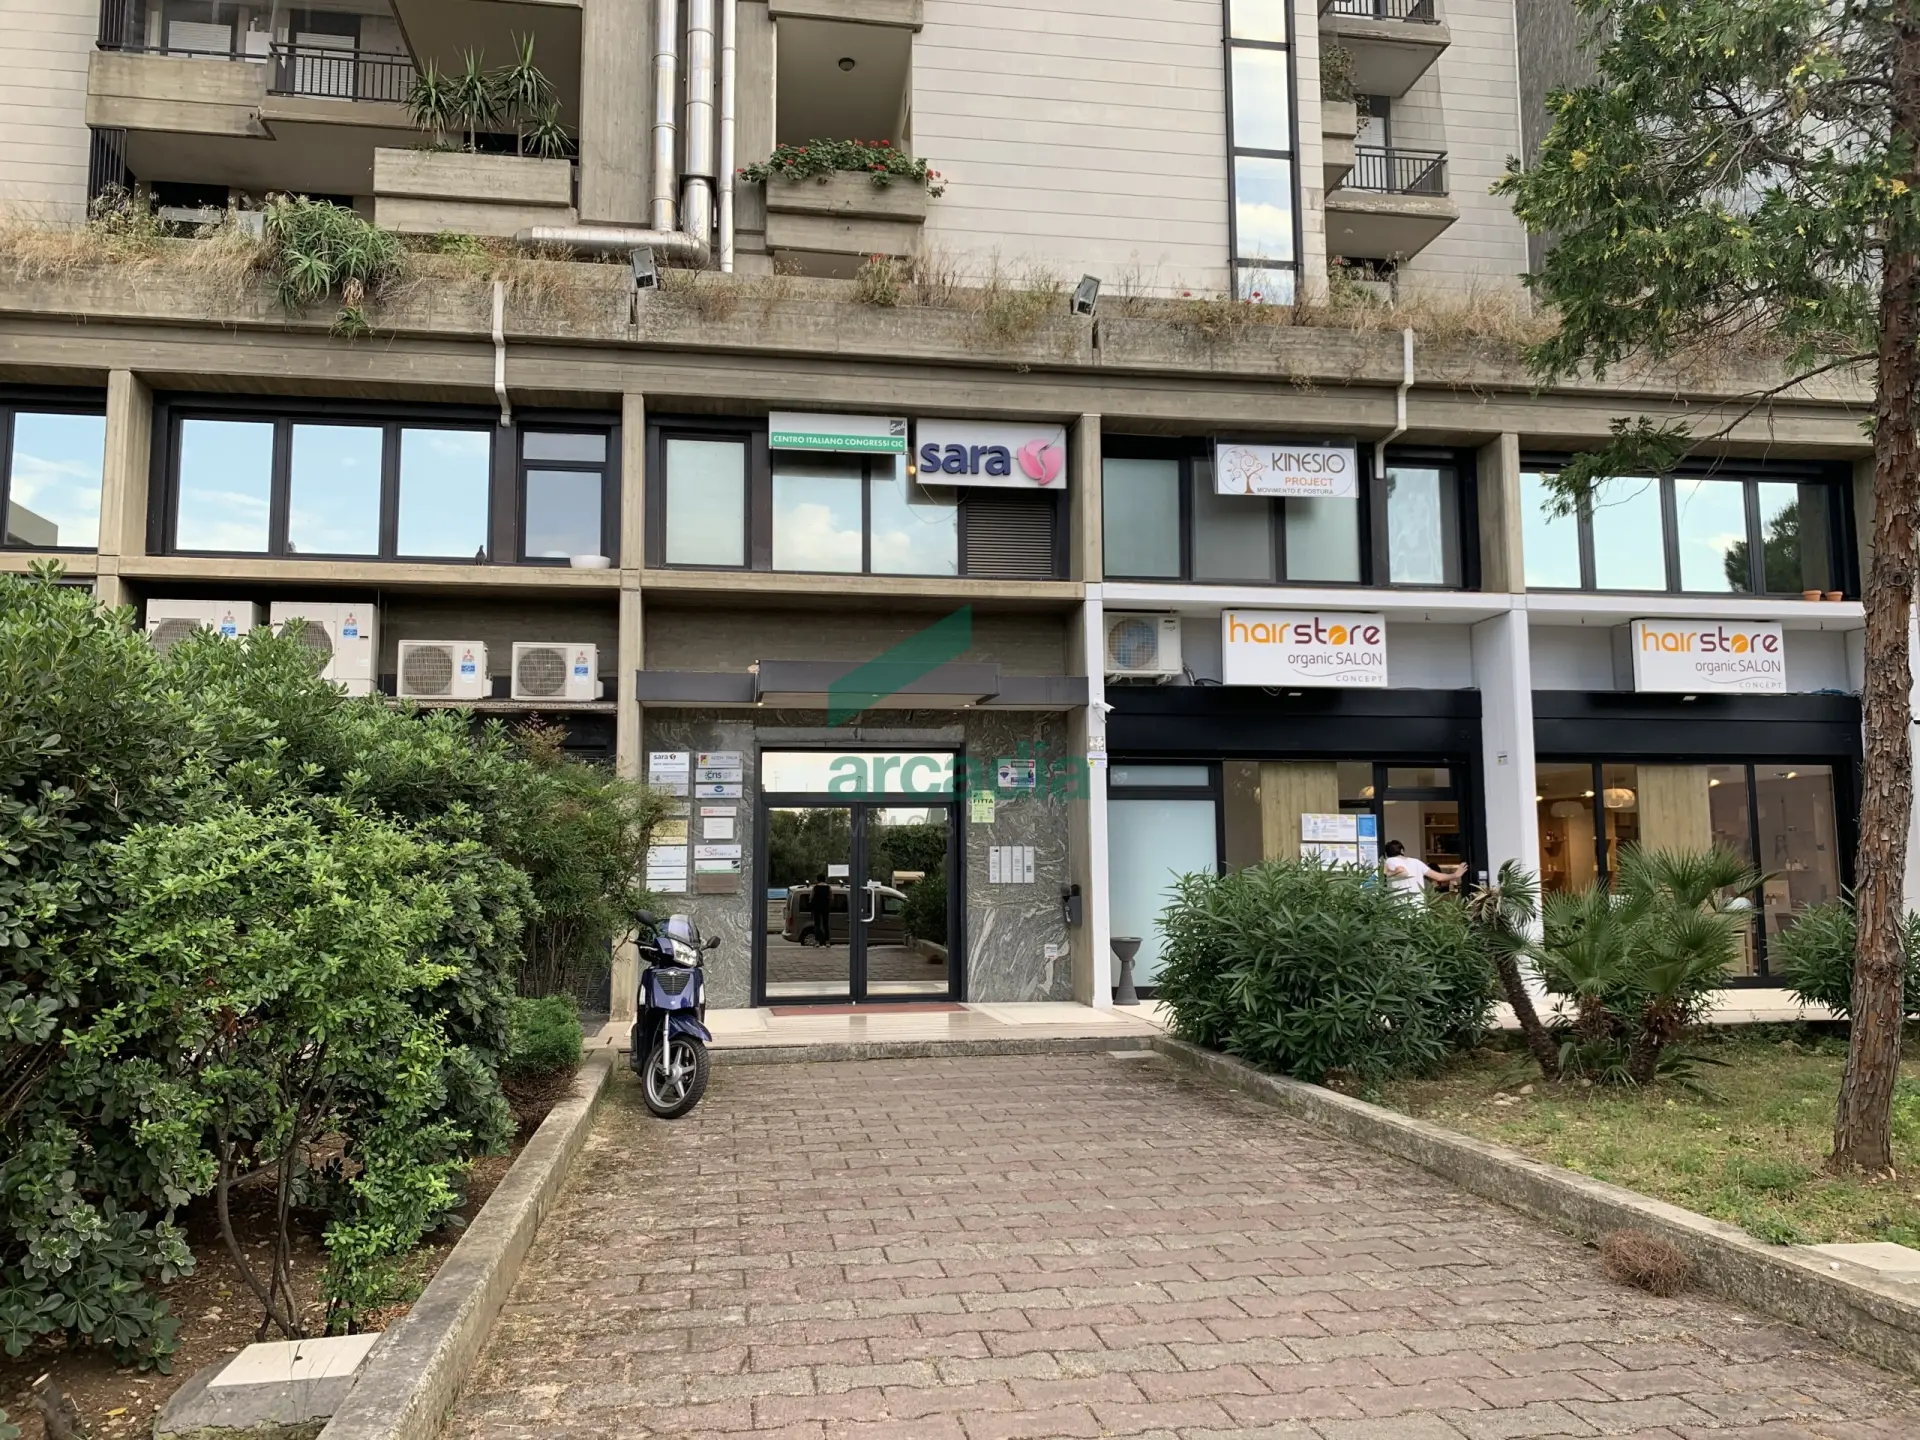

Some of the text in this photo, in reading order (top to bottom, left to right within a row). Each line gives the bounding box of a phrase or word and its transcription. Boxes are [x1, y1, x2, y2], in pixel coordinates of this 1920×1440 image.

[773, 435, 804, 443] CENTRO
[806, 436, 843, 445] ITALIANO
[845, 438, 889, 447] CONGRESSI
[920, 442, 1011, 475] sara
[1272, 452, 1345, 474] KINESIO
[1285, 477, 1334, 487] PROJECT
[1288, 652, 1382, 668] organic SALON
[1695, 660, 1780, 675] organic SALON
